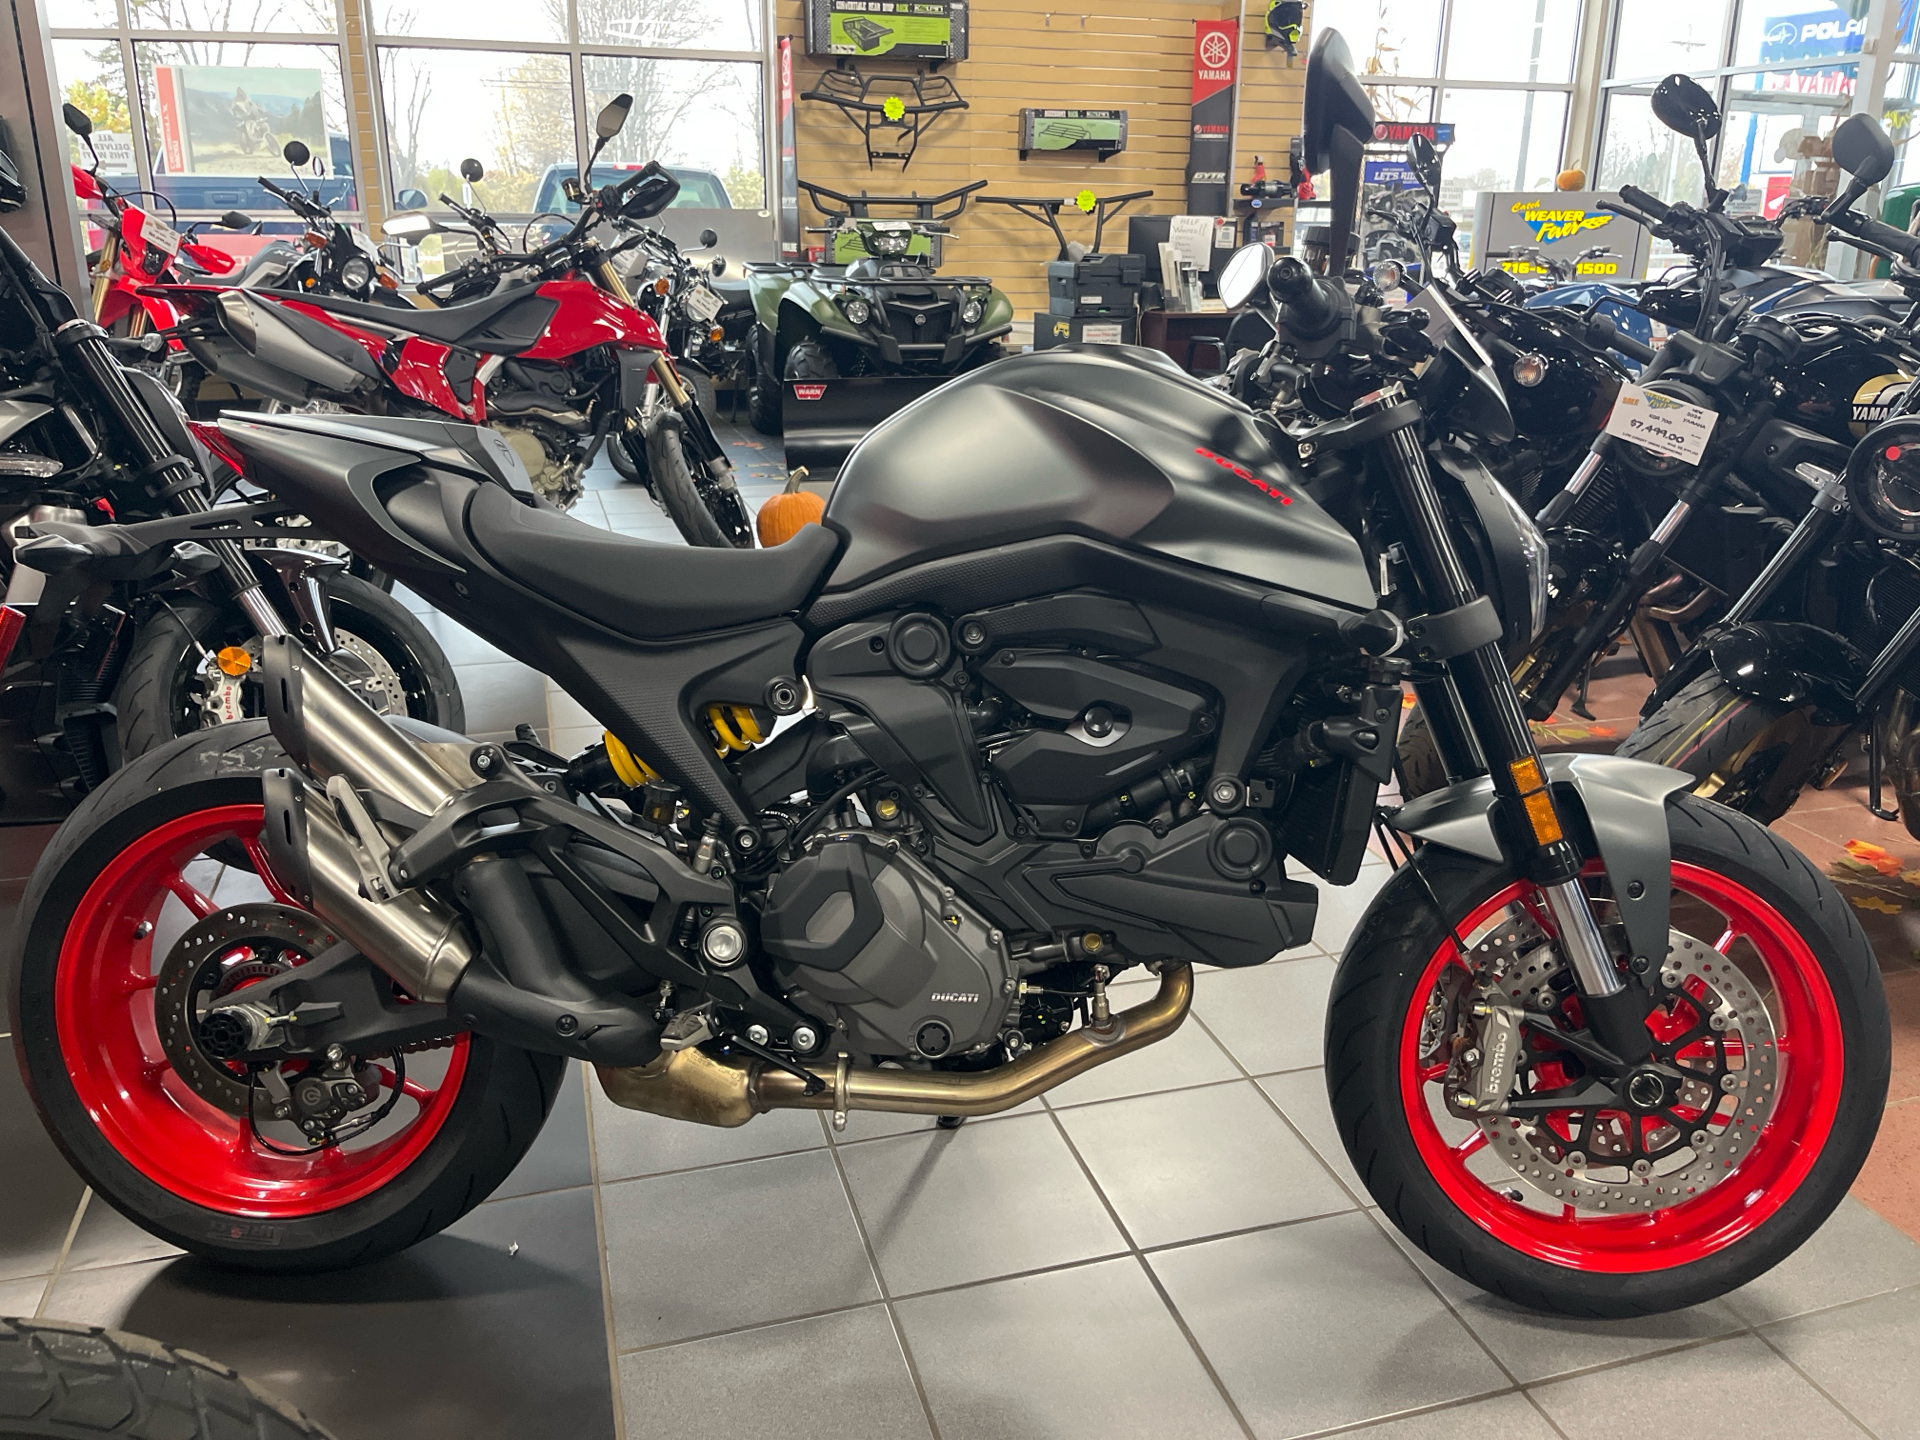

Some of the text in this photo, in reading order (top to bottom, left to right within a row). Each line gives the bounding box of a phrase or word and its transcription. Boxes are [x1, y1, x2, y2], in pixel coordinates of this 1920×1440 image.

[1800, 17, 1868, 42] POLA
[1198, 70, 1231, 80] YAMAHA
[1202, 125, 1229, 134] YAMAHA
[1193, 172, 1226, 180] GYTR
[1374, 171, 1418, 181] LET'S RID
[1511, 199, 1541, 213] Catch
[1524, 210, 1585, 222] WEAVER
[1622, 396, 1639, 406] SALE
[1648, 413, 1661, 421] XSR
[1686, 412, 1701, 420] 2024
[1853, 406, 1893, 420] YAMA
[1683, 418, 1706, 430] YAMAHA
[1630, 418, 1685, 444] $7,499.00
[1194, 446, 1294, 507] DUCATI
[223, 685, 233, 720] brembo
[930, 992, 979, 1004] DUCATI
[1485, 1032, 1508, 1093] brembo
